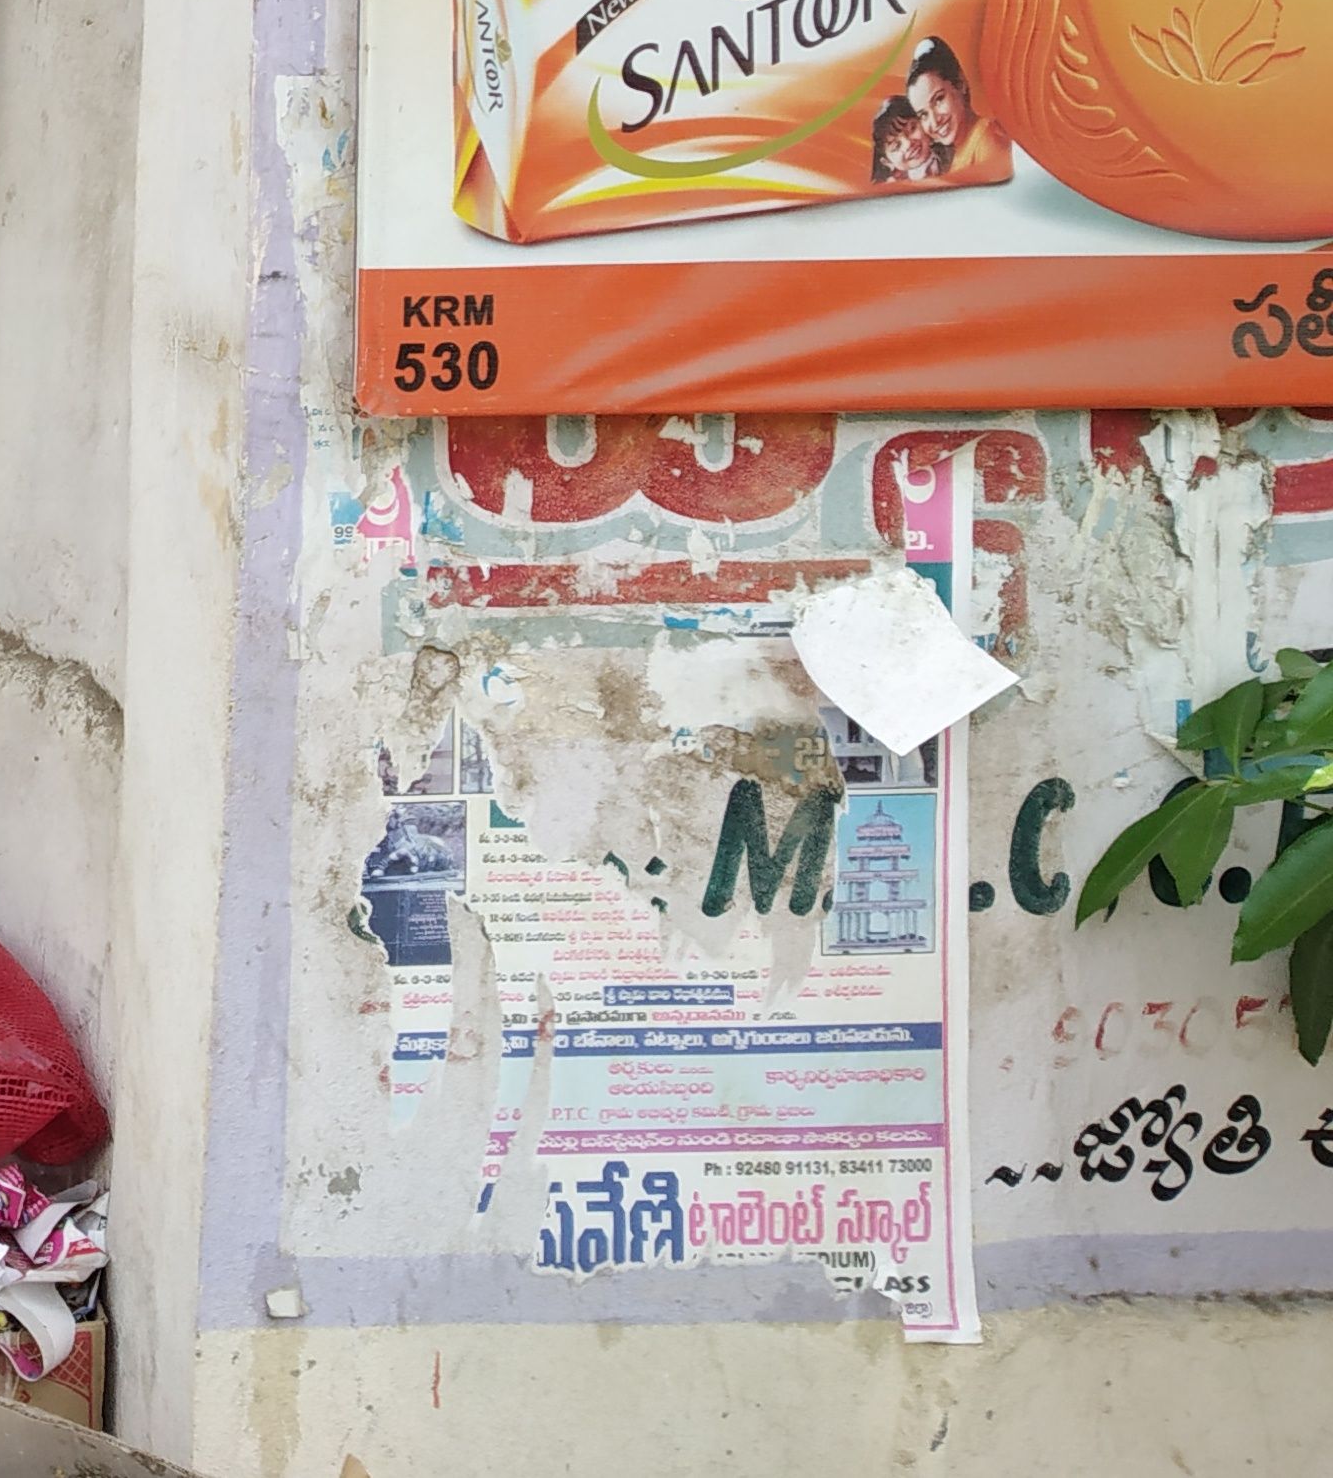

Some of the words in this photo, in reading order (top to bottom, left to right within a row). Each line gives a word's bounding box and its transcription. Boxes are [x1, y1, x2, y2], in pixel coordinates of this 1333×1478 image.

[402, 295, 496, 328] KRM
[393, 341, 499, 394] 530
[704, 1161, 724, 1177] Ph
[735, 1161, 781, 1176] 92480
[838, 1159, 884, 1175] 83411
[887, 1158, 933, 1173] 73000
